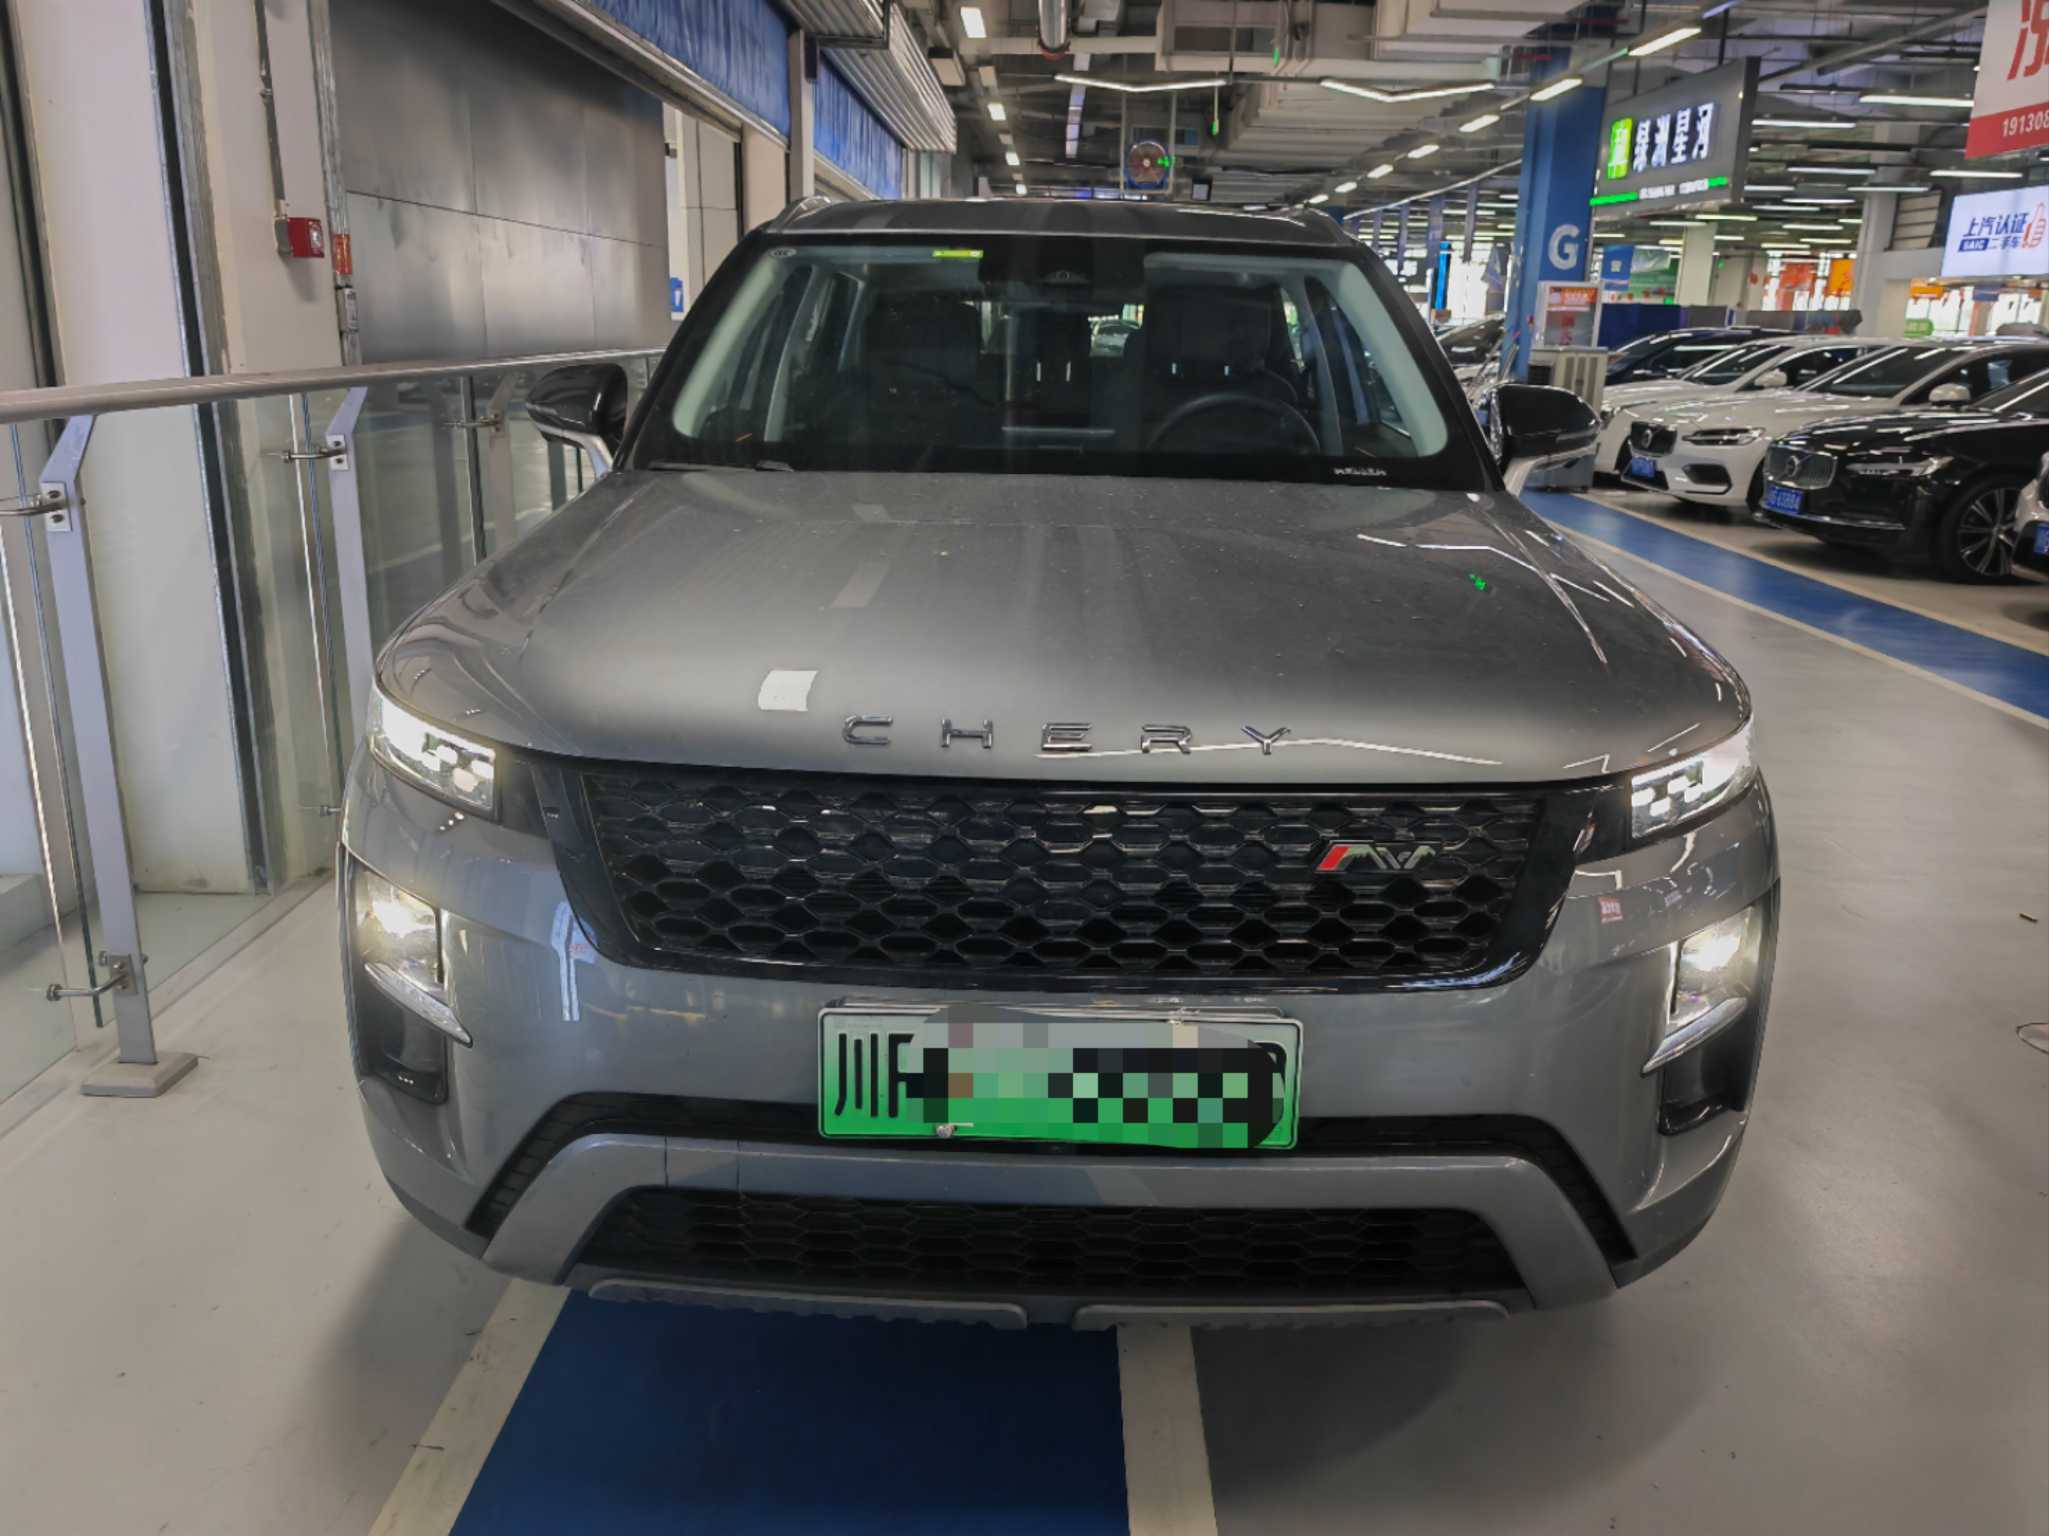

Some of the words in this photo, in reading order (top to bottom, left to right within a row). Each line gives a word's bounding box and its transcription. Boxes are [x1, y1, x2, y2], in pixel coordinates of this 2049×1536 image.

[1962, 212, 2030, 237] 上汽认证
[1548, 224, 1580, 270] G
[842, 714, 1292, 755] CHERY
